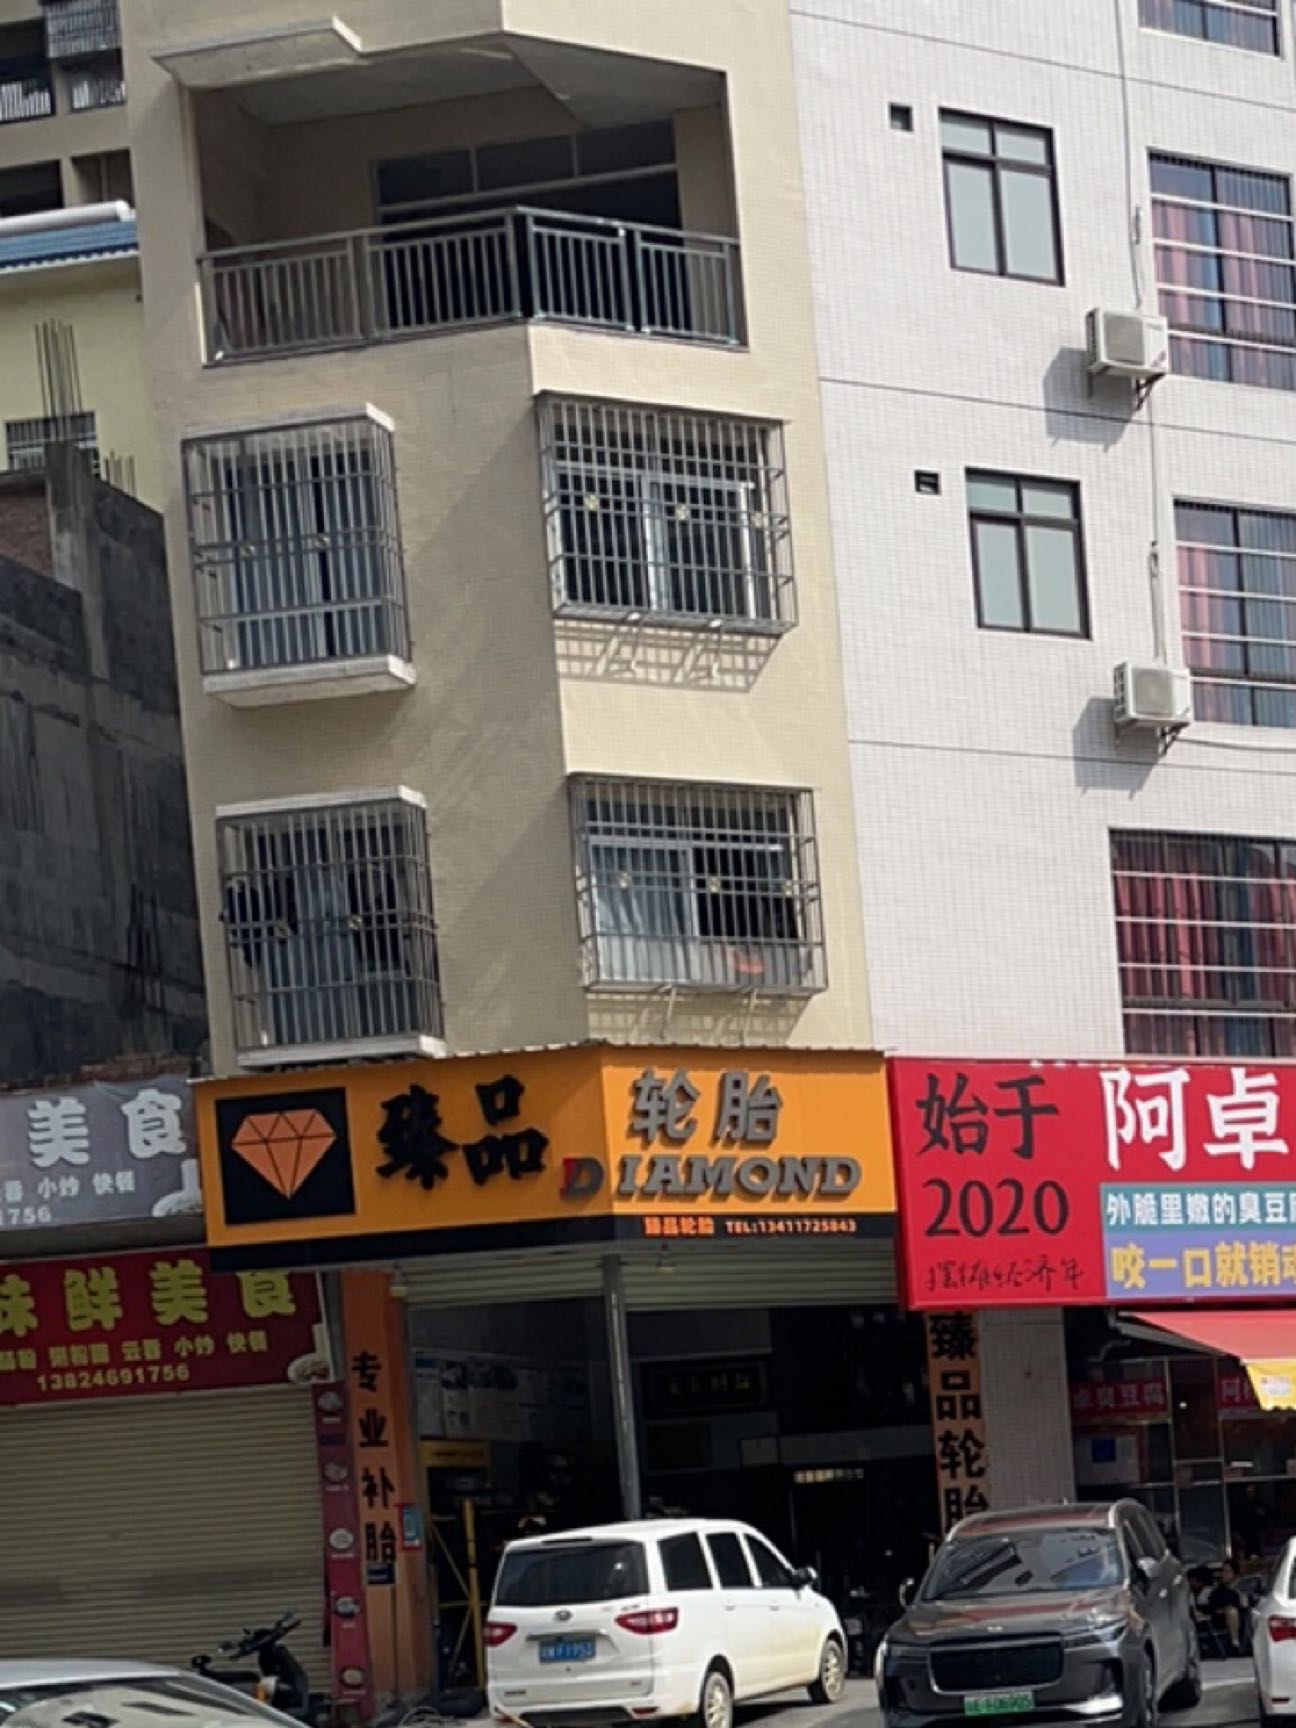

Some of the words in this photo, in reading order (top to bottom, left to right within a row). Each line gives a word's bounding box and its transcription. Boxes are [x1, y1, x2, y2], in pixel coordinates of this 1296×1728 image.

[628, 1066, 781, 1148] 轮胎
[914, 1072, 1060, 1159] 始于
[559, 1156, 862, 1201] DIAMOND
[921, 1178, 1069, 1237] 2020
[351, 1350, 398, 1563] 专业补胎
